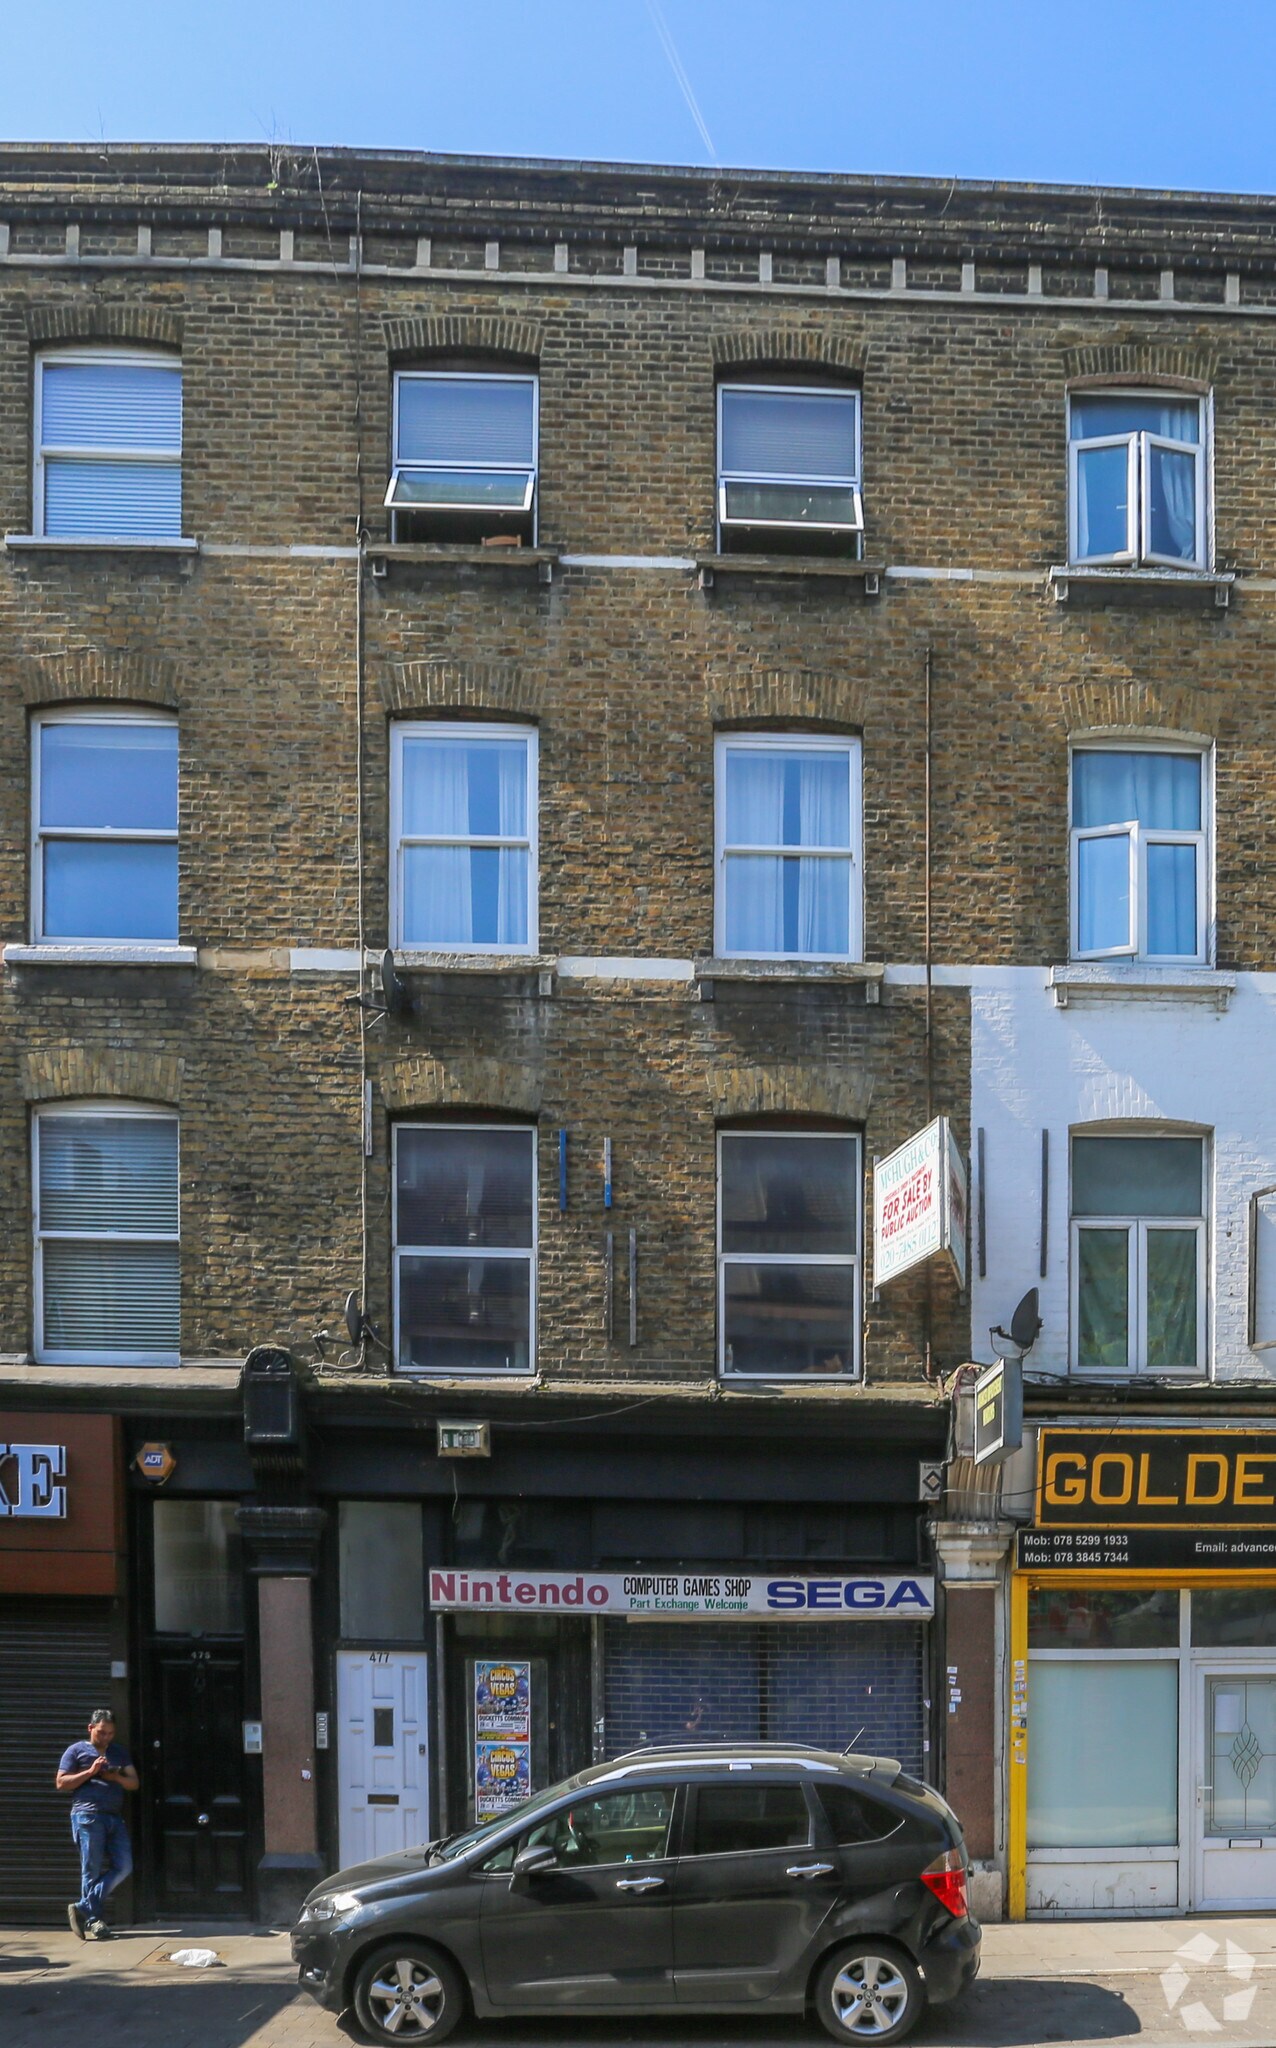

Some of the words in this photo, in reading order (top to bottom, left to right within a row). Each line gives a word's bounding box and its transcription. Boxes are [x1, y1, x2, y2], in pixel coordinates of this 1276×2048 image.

[882, 1197, 900, 1224] FOR
[902, 1179, 921, 1211] SALE
[923, 1168, 932, 1194] BY
[881, 1213, 905, 1242] PUBLIC
[906, 1191, 932, 1225] AUCTION
[145, 1453, 163, 1465] ADT
[0, 1443, 66, 1518] E
[1045, 1453, 1276, 1505] GOLDE
[1024, 1535, 1050, 1546] Mob:
[1053, 1535, 1072, 1546] 078
[1075, 1535, 1100, 1546] 5299
[1104, 1535, 1128, 1546] 1933
[1195, 1542, 1228, 1553] Email:
[1230, 1542, 1276, 1553] advance
[1024, 1552, 1051, 1563] Mob:
[1054, 1552, 1073, 1563] 078
[1076, 1552, 1101, 1563] 3845
[1104, 1552, 1129, 1563] 7344
[431, 1573, 609, 1606] Nintendo
[623, 1577, 679, 1597] COMPUTER
[684, 1578, 721, 1597] GAMES
[725, 1579, 752, 1598] SHOP
[766, 1580, 932, 1609] SEGA
[630, 1597, 650, 1609] Part
[655, 1598, 699, 1611] Exchange
[704, 1598, 748, 1610] Welcome
[369, 1652, 390, 1663] 477
[490, 1668, 515, 1682] CIRCUS
[490, 1682, 515, 1697] VEGAS
[490, 1749, 515, 1764] CIRCUS
[490, 1763, 515, 1778] VEGAS
